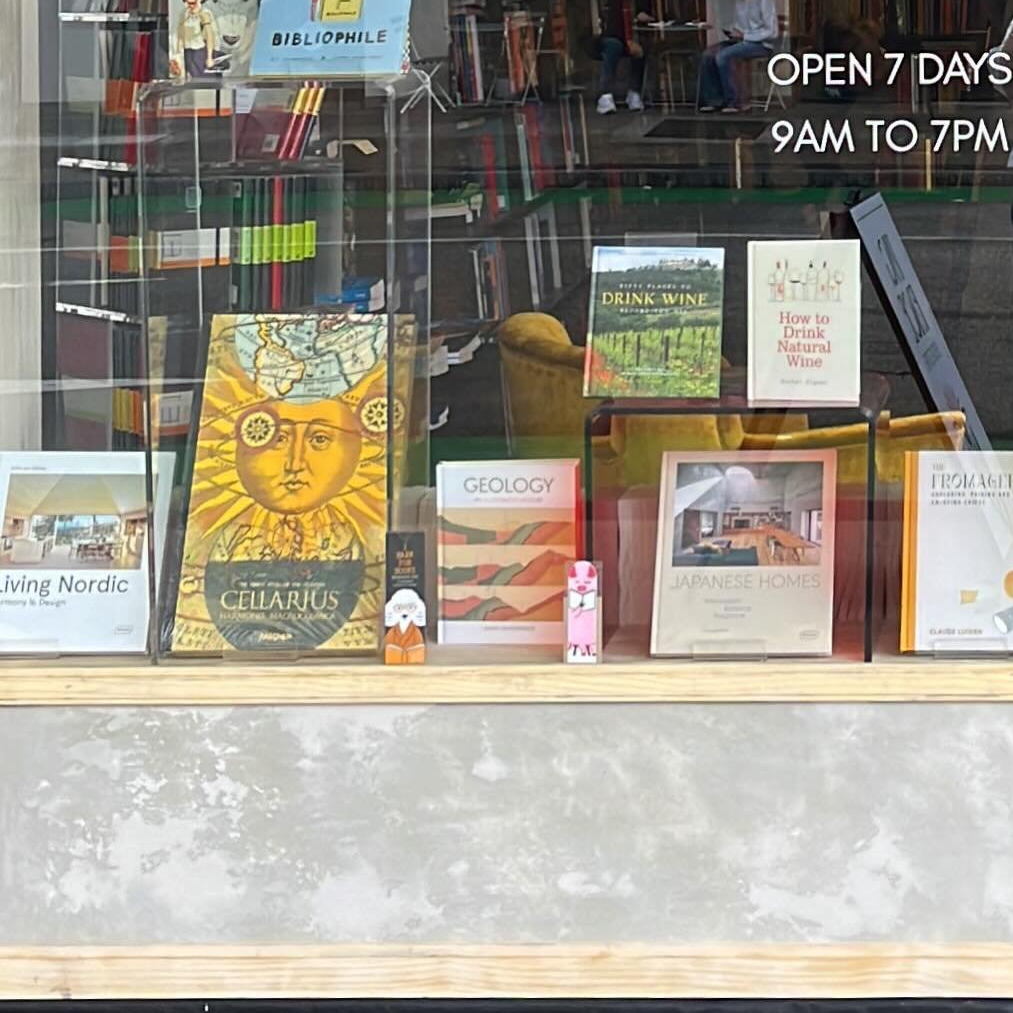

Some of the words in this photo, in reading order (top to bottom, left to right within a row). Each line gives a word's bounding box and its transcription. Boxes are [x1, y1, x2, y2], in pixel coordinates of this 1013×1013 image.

[271, 29, 388, 46] BIBLIOPHILE
[767, 52, 872, 86] OPEN
[884, 52, 905, 85] 7
[918, 52, 1013, 85] DAYS
[771, 118, 855, 153] 9AM
[865, 119, 918, 153] TO
[930, 118, 1009, 153] 7PM
[602, 291, 656, 306] DRINK
[661, 291, 709, 306] WINE
[779, 311, 811, 325] How
[815, 312, 830, 325] to
[783, 325, 825, 339] Drink
[777, 340, 832, 353] Natural
[787, 354, 823, 368] Wine
[463, 477, 555, 494] GEOLOGY
[0, 575, 51, 597] iving
[58, 575, 129, 594] Nordic
[671, 573, 753, 589] JAPANESE
[759, 573, 822, 589] HOMES
[220, 590, 339, 611] CELLARIUS
